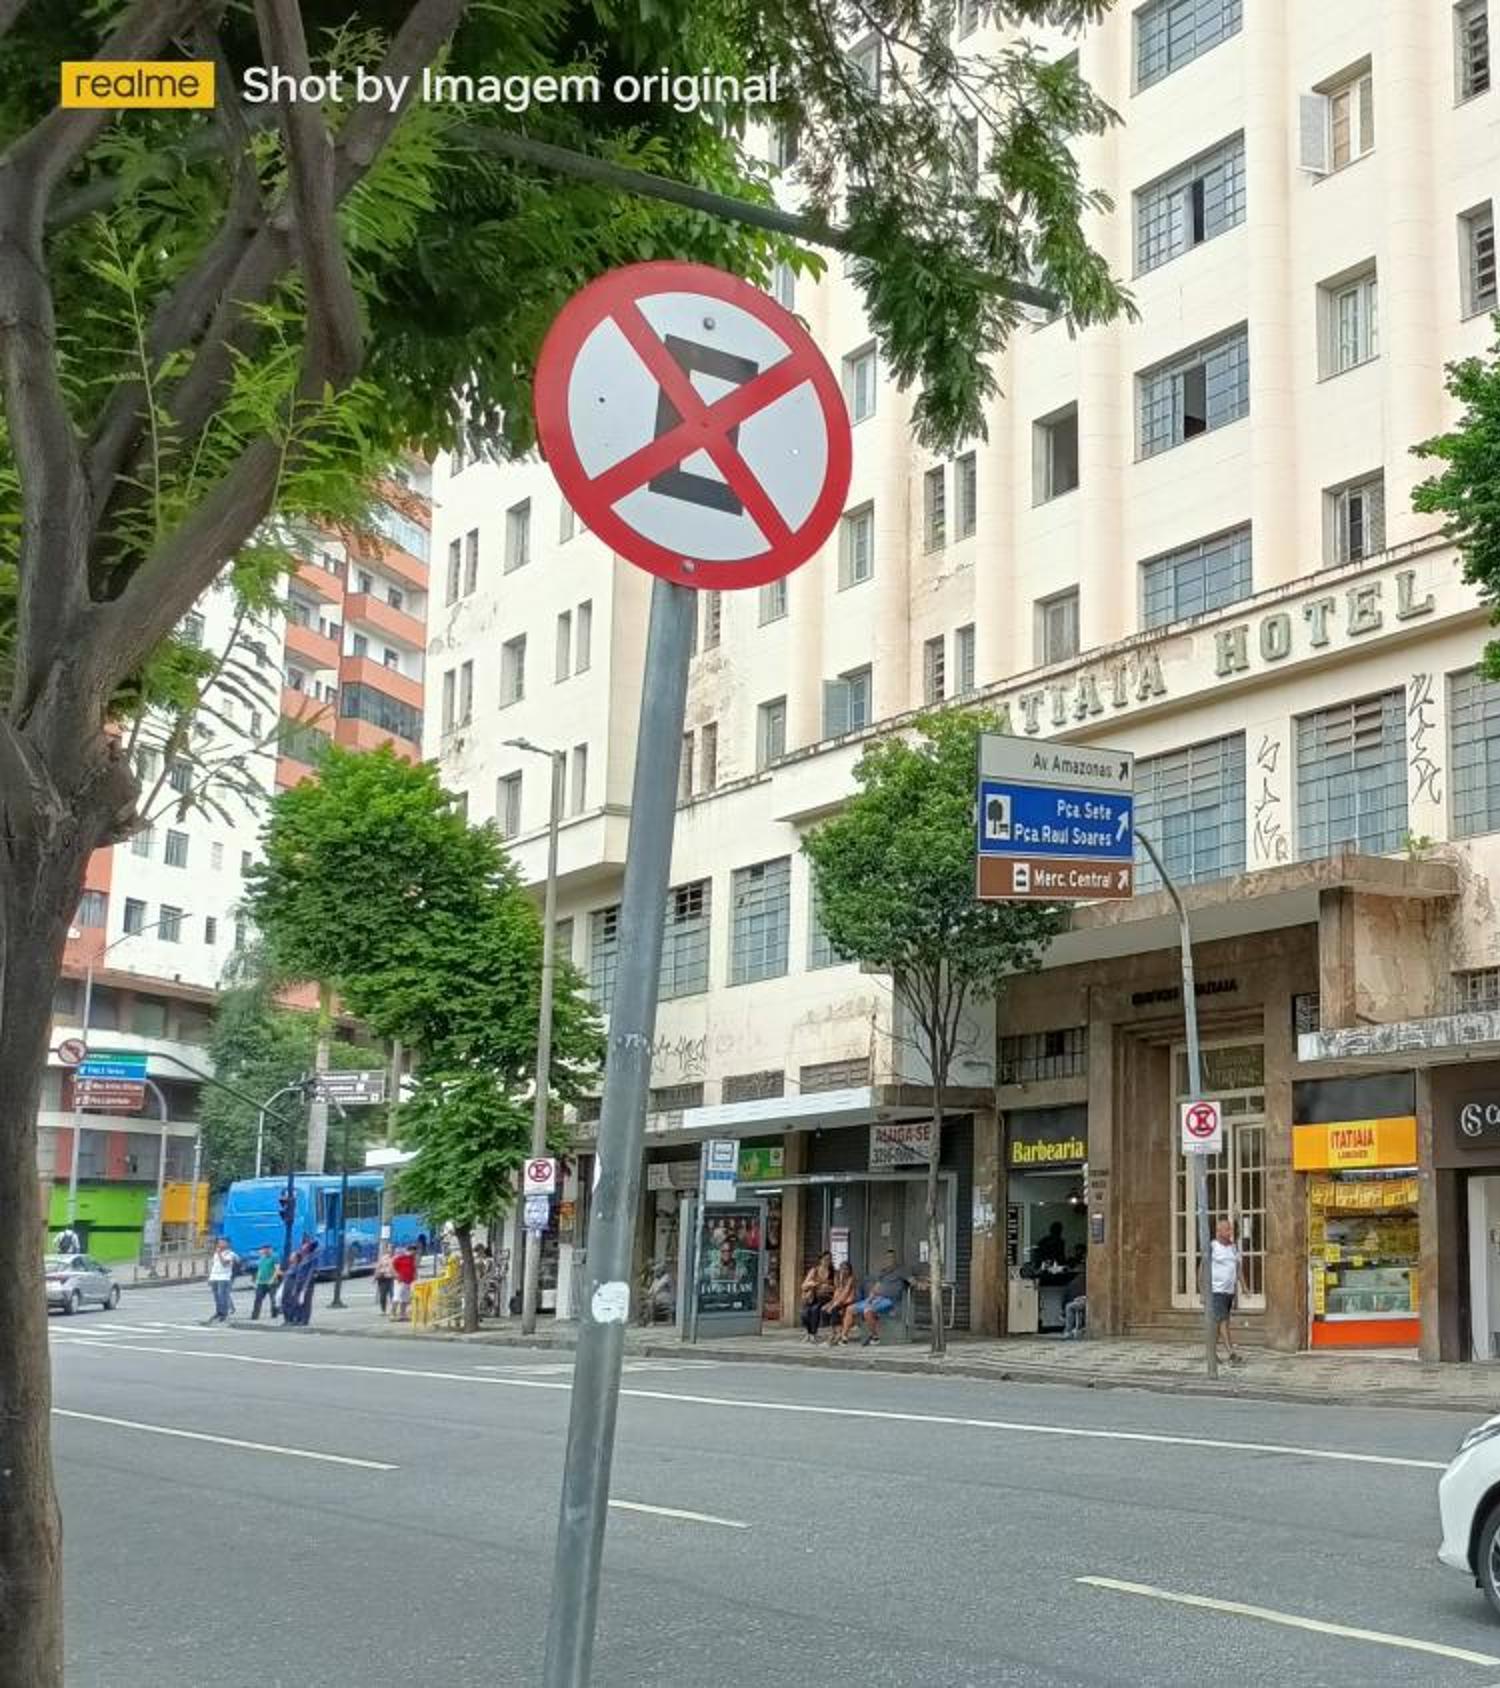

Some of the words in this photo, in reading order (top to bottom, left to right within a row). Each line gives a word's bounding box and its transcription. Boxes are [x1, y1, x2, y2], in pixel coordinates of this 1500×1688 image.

[1214, 570, 1434, 677] HOTEL
[1052, 755, 1113, 778] Amazonas
[1084, 801, 1113, 821] Sete
[1041, 825, 1069, 844] Raul
[1072, 827, 1113, 847] Soares
[1069, 869, 1111, 888] Central
[1013, 1136, 1084, 1163] Barbearia
